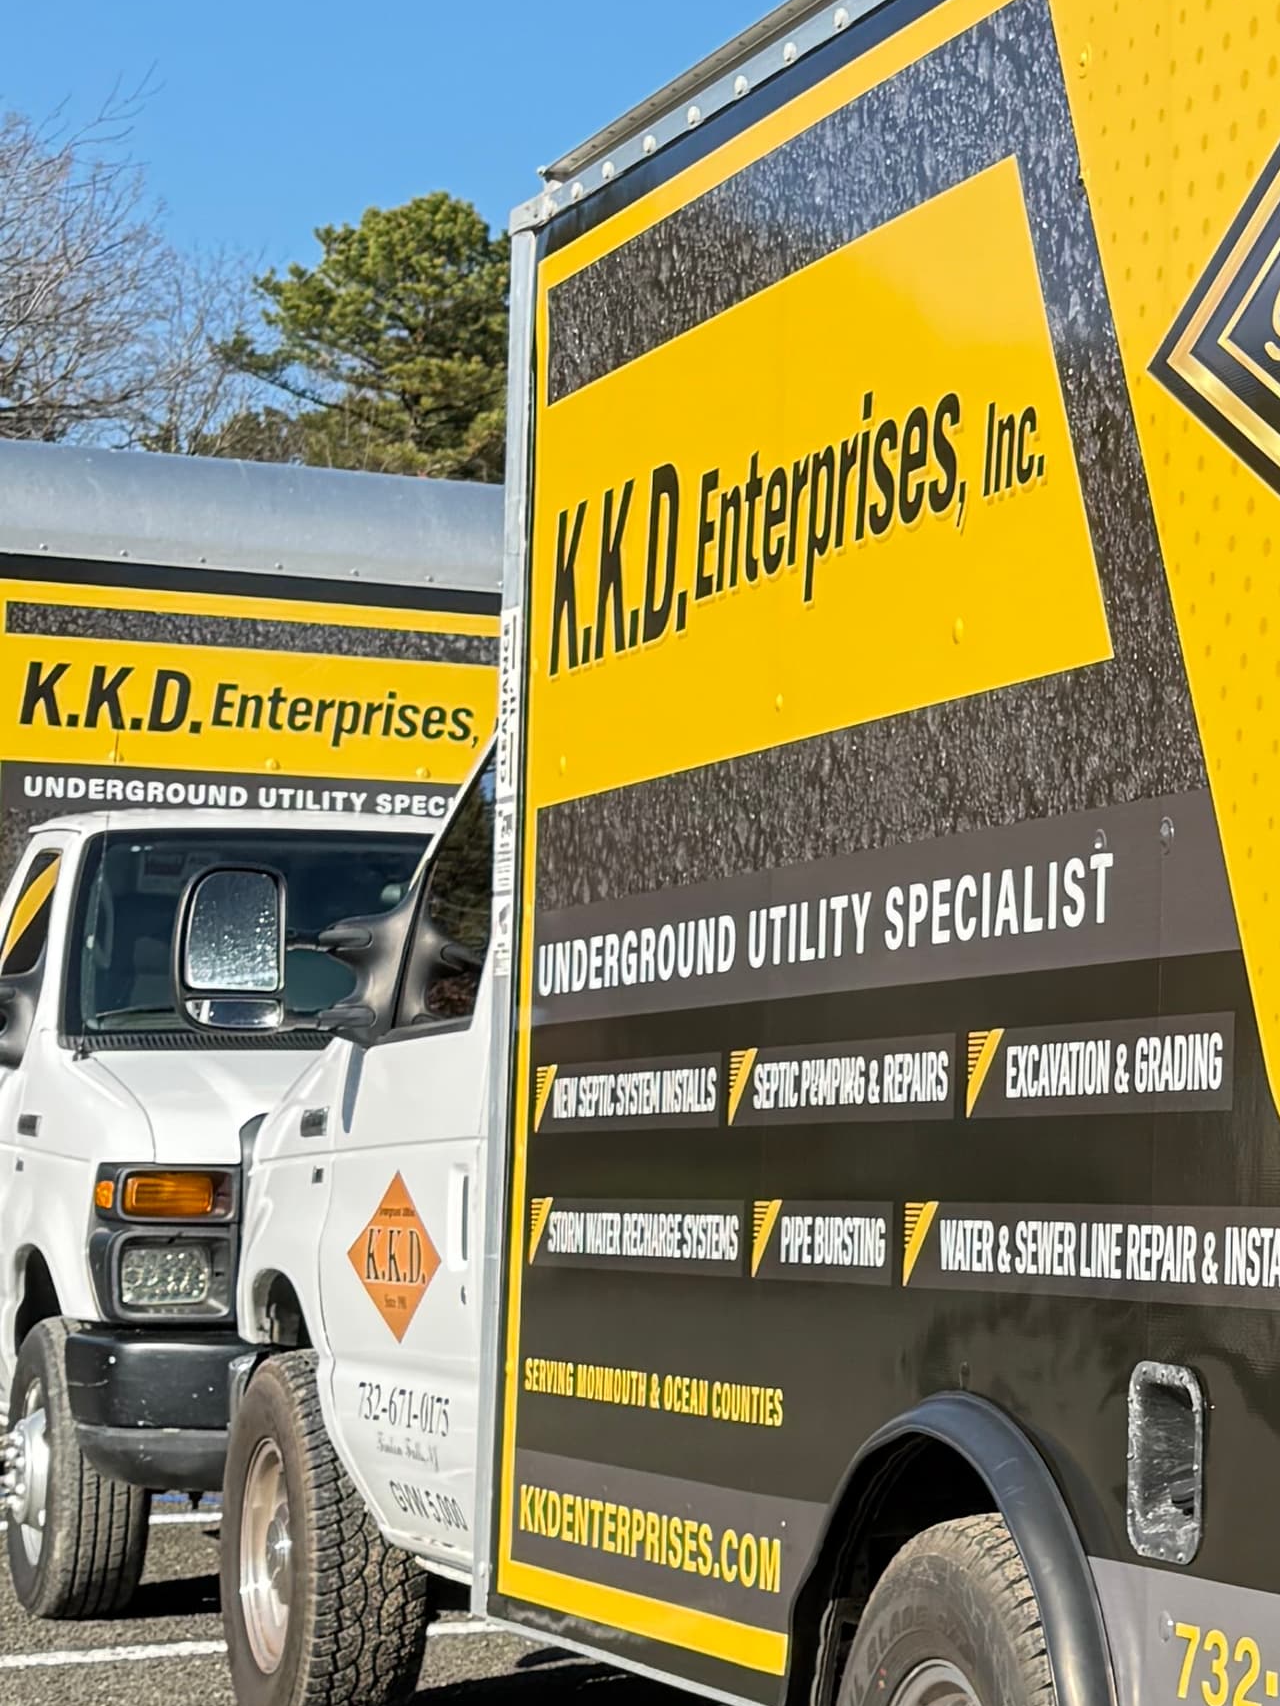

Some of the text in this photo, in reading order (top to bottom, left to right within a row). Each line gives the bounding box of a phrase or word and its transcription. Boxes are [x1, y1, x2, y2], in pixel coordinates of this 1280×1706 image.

[549, 391, 1045, 677] K.K.D. Enterprises, Inc.
[19, 661, 480, 748] K.K.D. Enterprises,
[23, 776, 248, 808] UNDERGROUND
[258, 788, 367, 813] UTILITY
[538, 915, 736, 996] UNDERGROUND
[748, 891, 872, 969] UTILITY
[884, 853, 1113, 950] SPECIALIST
[552, 1067, 717, 1119] NEW SEPTIC SYSTEM INSTALLS
[752, 1051, 948, 1110] SEPTIC PUMPING & REPAIRS
[1006, 1032, 1223, 1098] EXCAVATION & GRADING
[366, 1228, 426, 1284] K.K.D.
[548, 1211, 739, 1261] STORM WATER RECHARGE SYSTEMS
[780, 1216, 885, 1267] PIPE BURSTING
[940, 1219, 994, 1272] WATER
[997, 1225, 1011, 1274] &
[1015, 1221, 1075, 1278] SEWER
[1080, 1223, 1122, 1280] LINE
[1126, 1224, 1196, 1284] REPAIR
[1202, 1235, 1218, 1285] &
[359, 1381, 449, 1437] 732-671-0175
[524, 1357, 783, 1427] SERVING MONMOUTH & OCEAN COUNTIES
[519, 1484, 781, 1593] KKDENTERPRISES.COM
